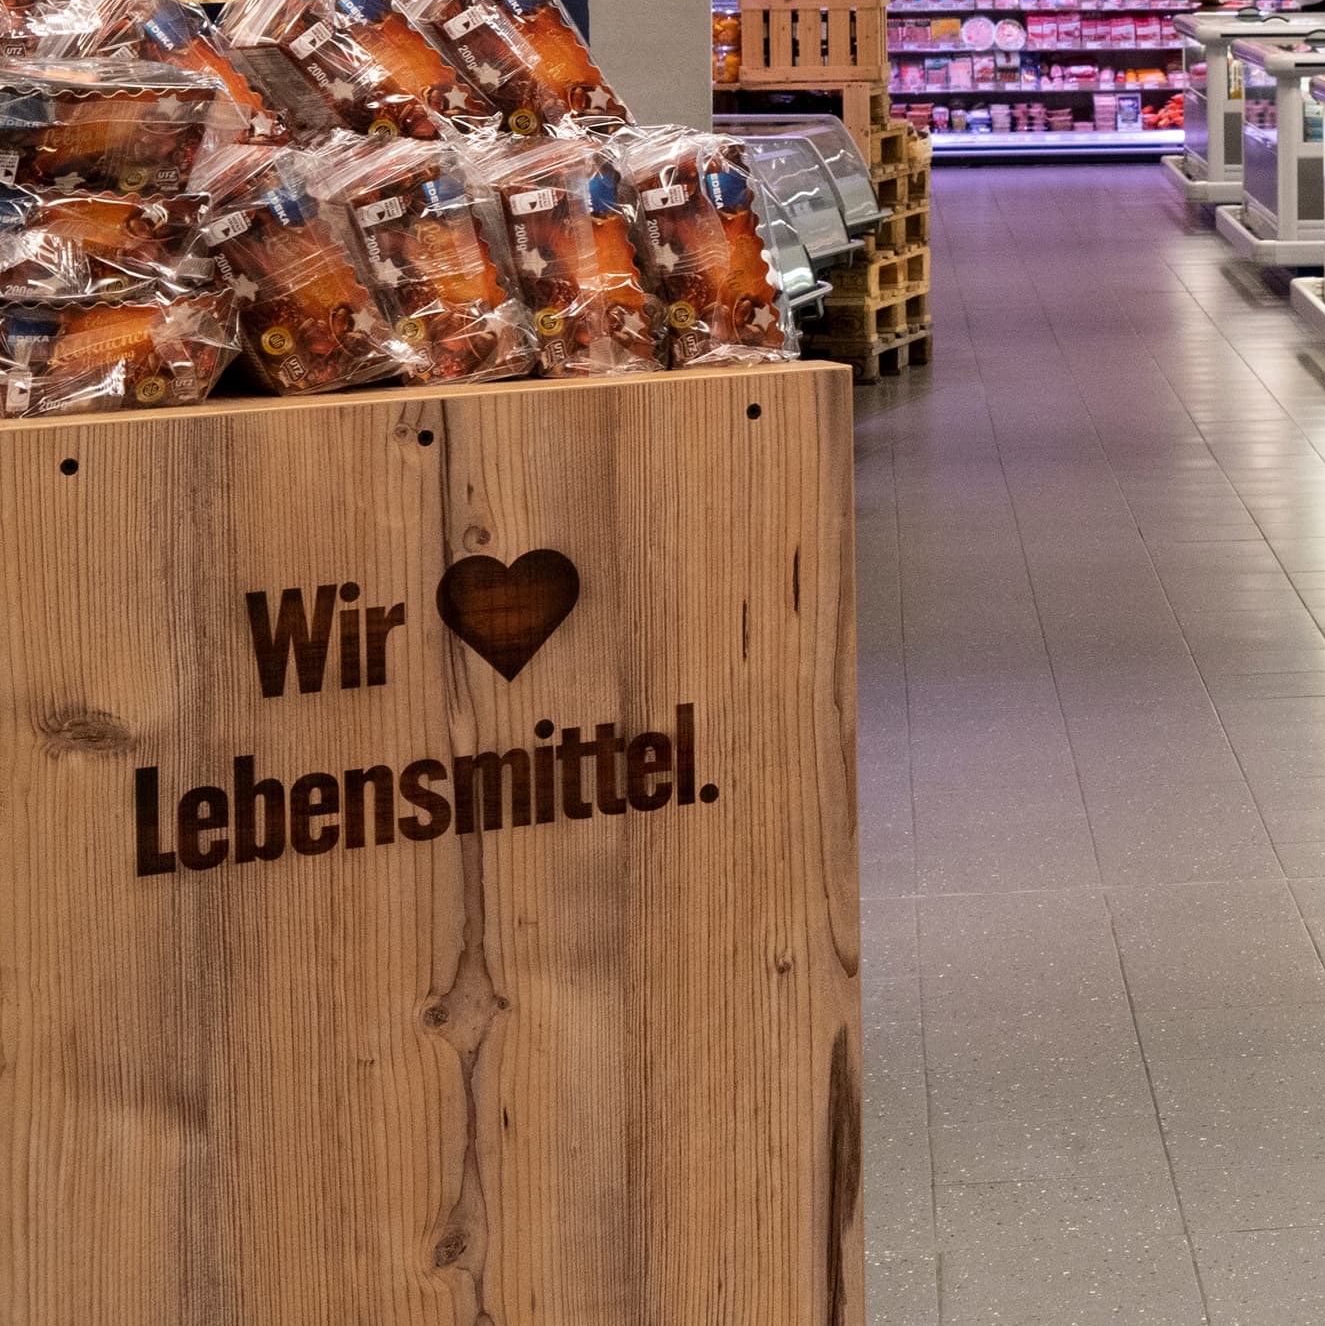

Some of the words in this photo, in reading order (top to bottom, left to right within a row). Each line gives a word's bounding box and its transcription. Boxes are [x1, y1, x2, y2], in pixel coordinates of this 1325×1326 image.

[6, 46, 23, 57] UTZ
[457, 44, 477, 72] 200g
[305, 62, 328, 88] 200g
[158, 171, 177, 179] UTZ
[709, 172, 724, 211] EDEKA
[365, 235, 381, 263] 200g
[515, 223, 526, 252] 200g
[213, 252, 234, 281] 200g
[686, 335, 698, 356] UTZ
[288, 358, 303, 377] UTZ
[175, 380, 194, 388] UTZ
[245, 580, 406, 700] Wir
[133, 702, 721, 877] Lebensmittel.
